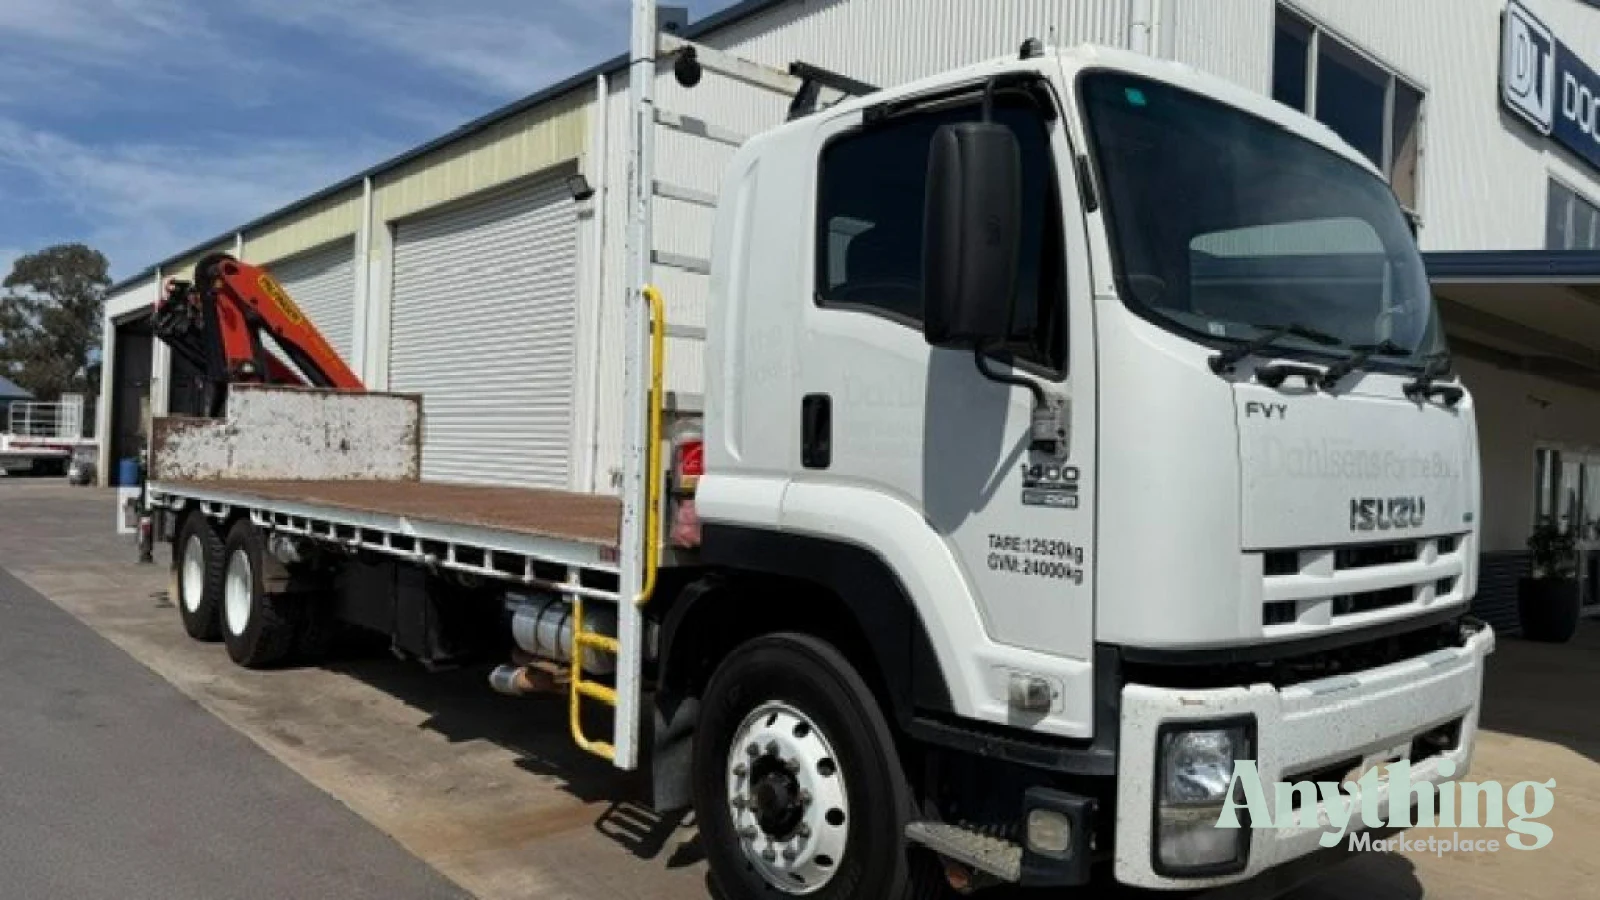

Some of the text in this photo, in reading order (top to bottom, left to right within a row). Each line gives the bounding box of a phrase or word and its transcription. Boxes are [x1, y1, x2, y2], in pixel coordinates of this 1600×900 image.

[1245, 401, 1288, 420] FVY
[1258, 433, 1380, 480] Dahlsens
[1350, 496, 1426, 532] ISUZU
